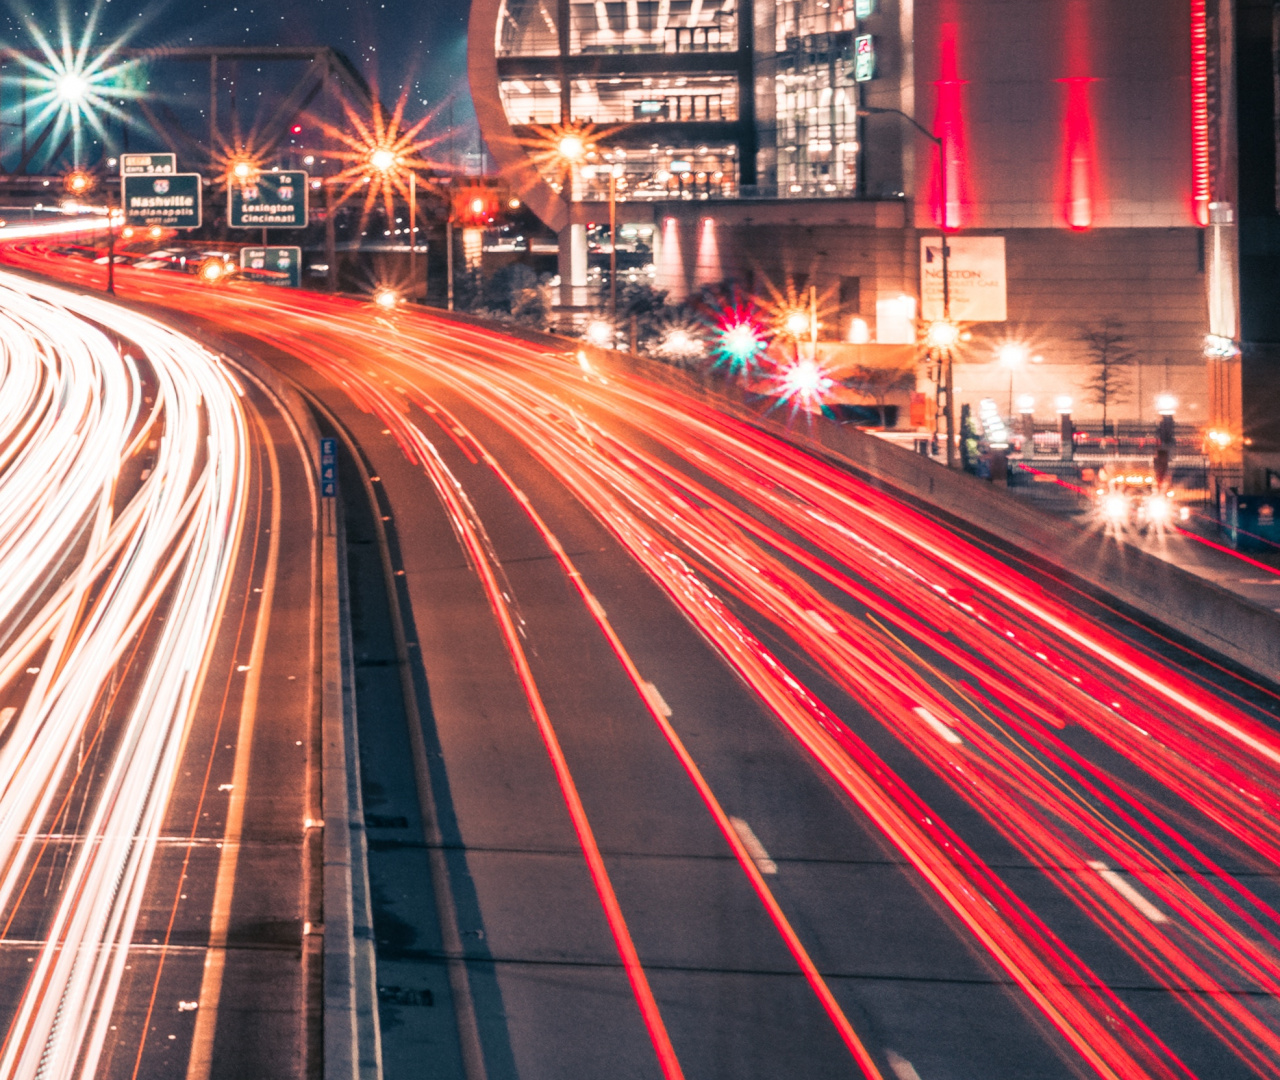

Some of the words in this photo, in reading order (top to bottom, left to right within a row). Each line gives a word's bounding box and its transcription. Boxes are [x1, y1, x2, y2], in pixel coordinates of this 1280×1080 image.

[130, 196, 194, 208] Nashville
[128, 209, 194, 218] Indianapolis
[241, 204, 295, 215] Lexington
[241, 214, 296, 223] Cincinnati
[324, 441, 333, 454] E
